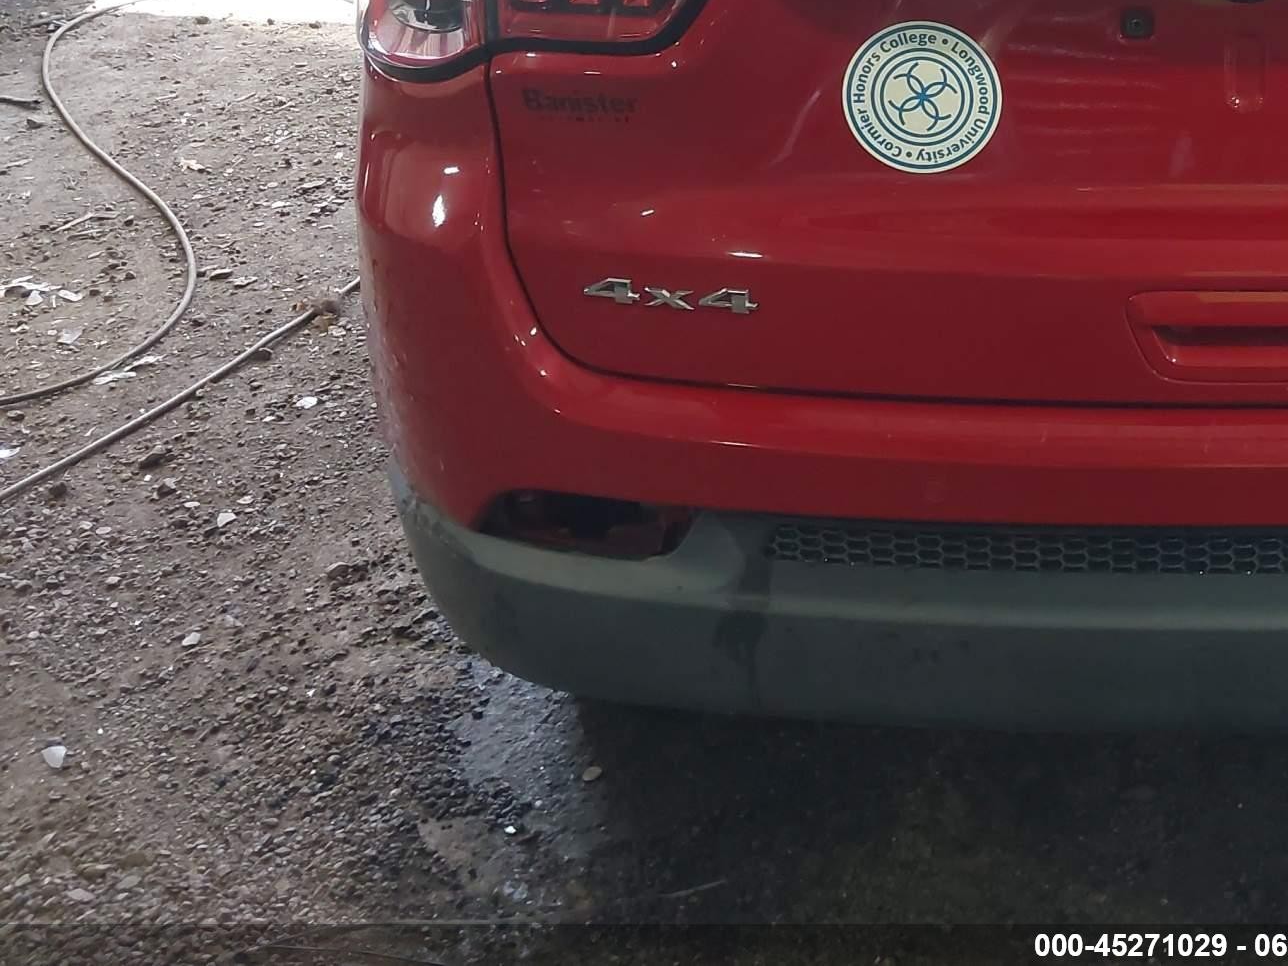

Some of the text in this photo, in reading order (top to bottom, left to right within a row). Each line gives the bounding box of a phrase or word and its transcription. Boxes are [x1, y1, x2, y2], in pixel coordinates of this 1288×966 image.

[853, 32, 937, 158] Cormier Honors College
[916, 42, 990, 163] Longwood University
